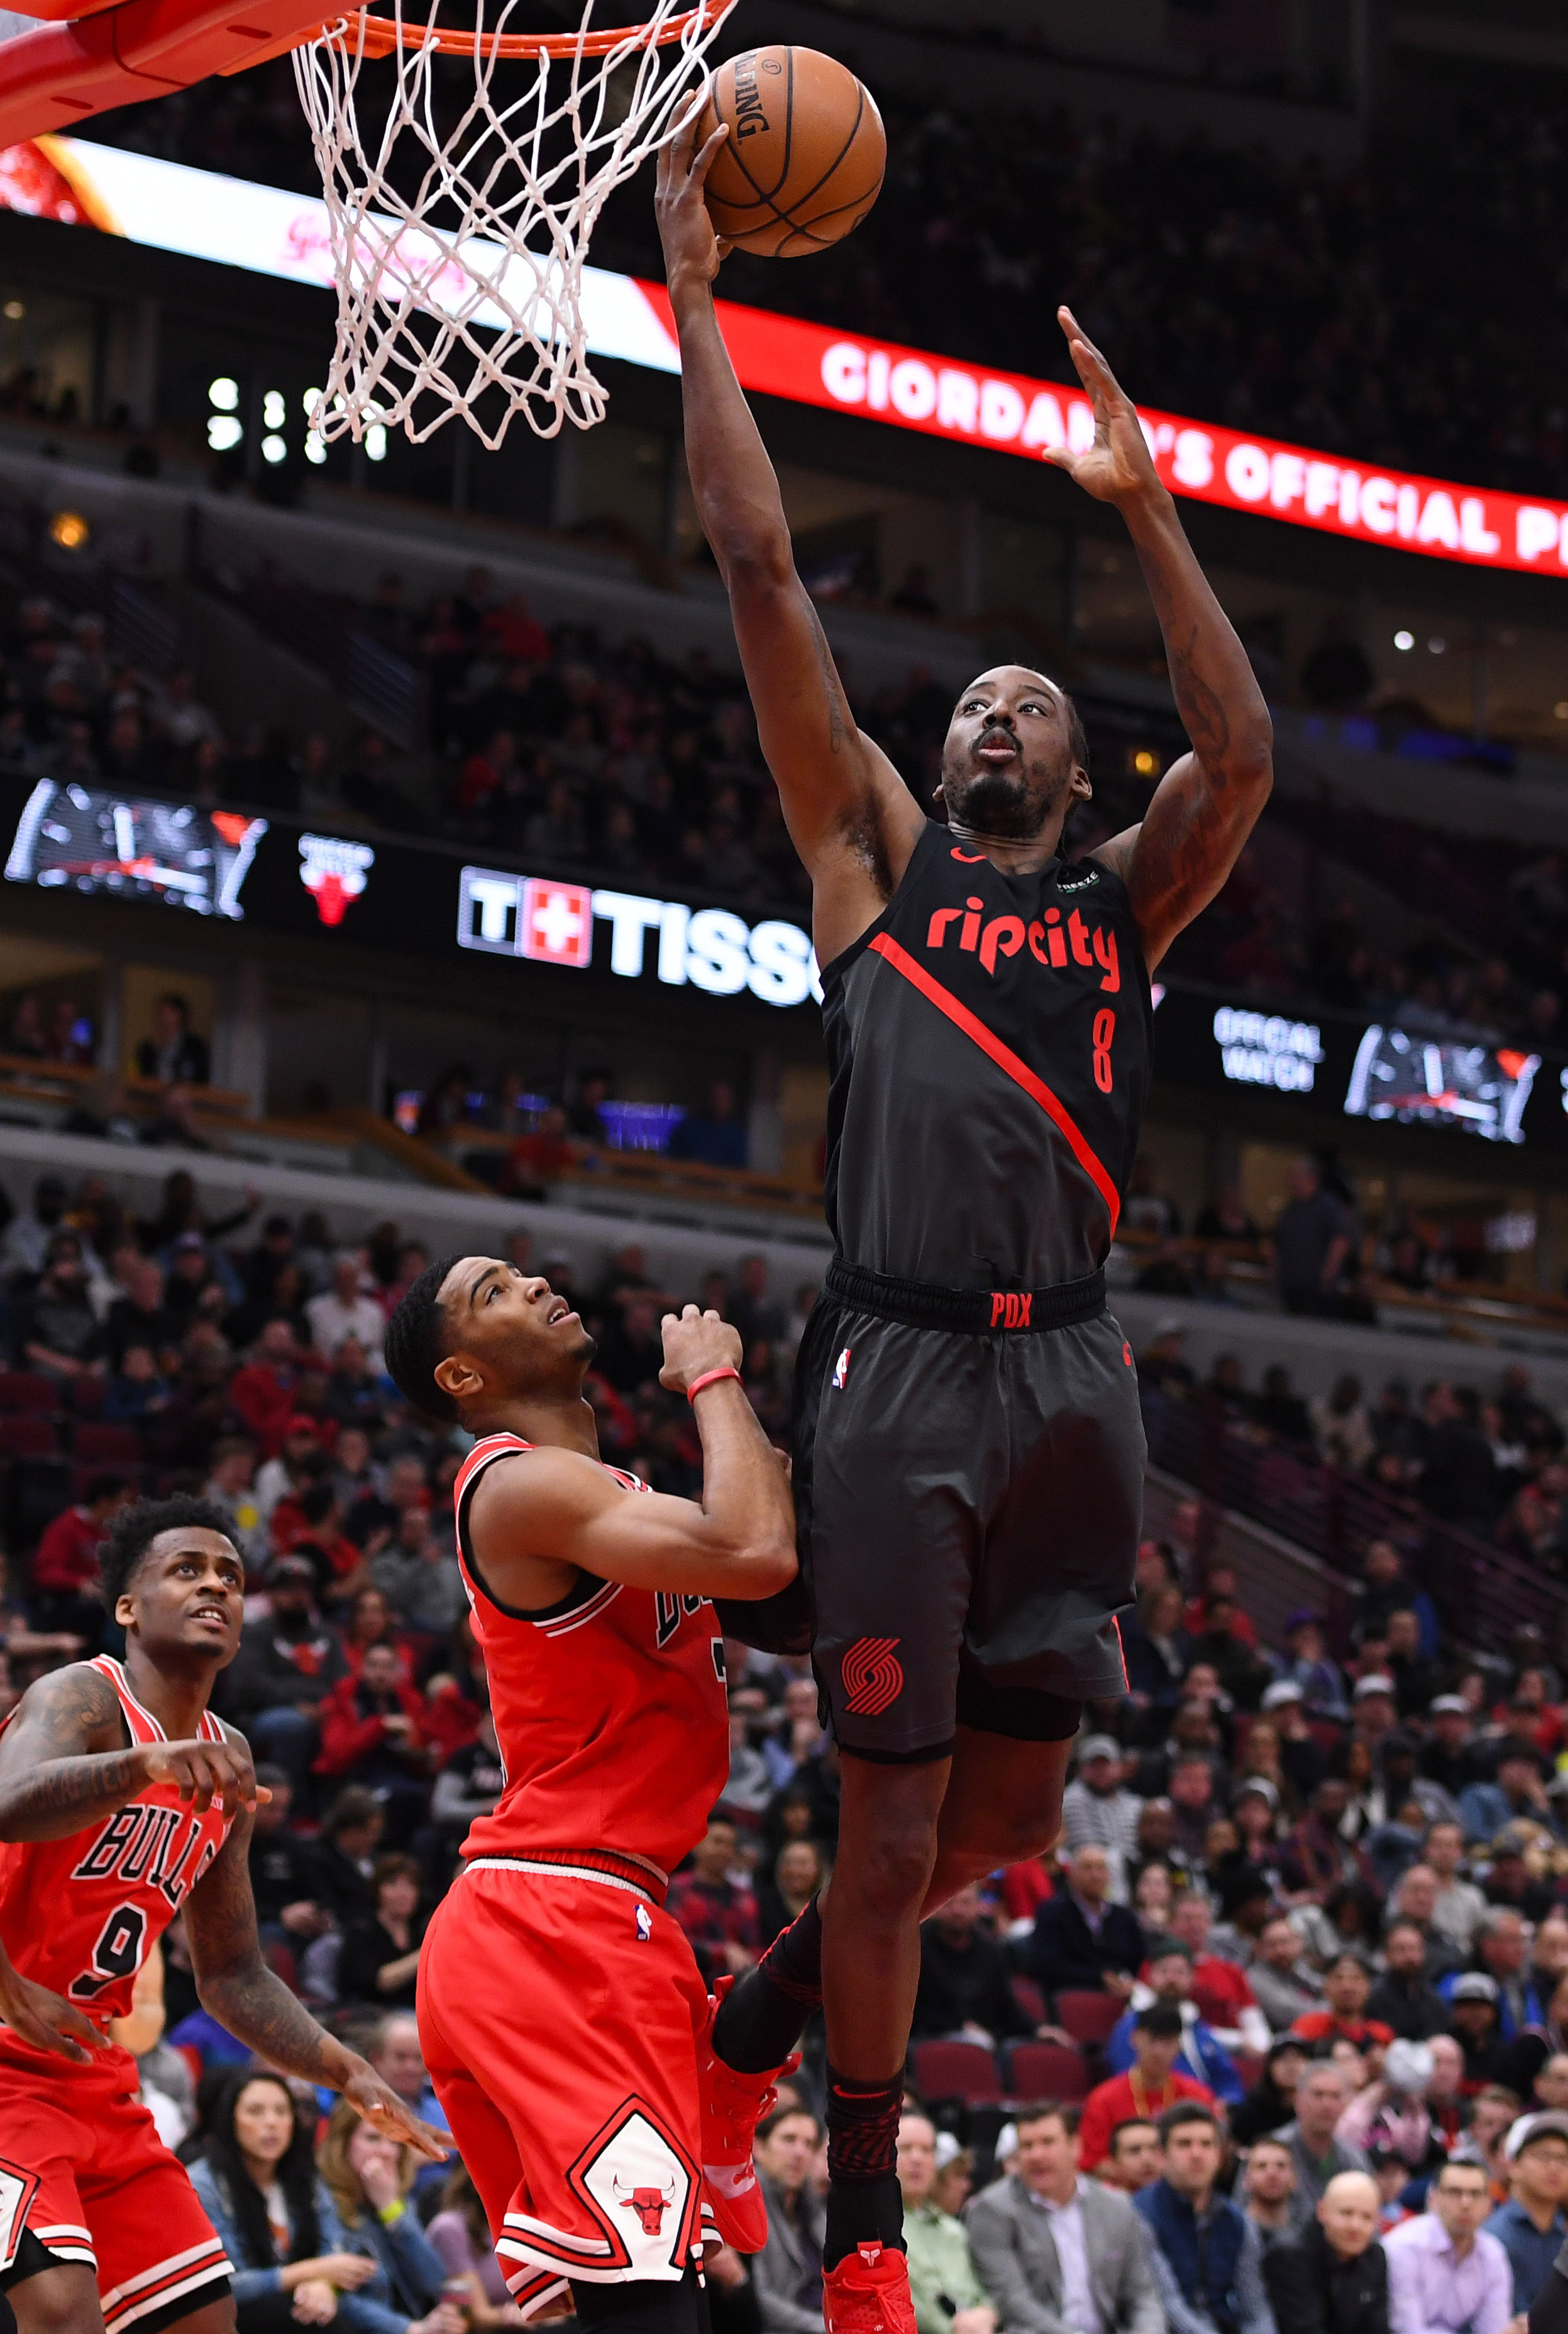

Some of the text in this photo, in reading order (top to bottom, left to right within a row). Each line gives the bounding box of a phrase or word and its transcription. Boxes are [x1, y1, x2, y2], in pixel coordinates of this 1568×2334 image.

[1225, 443, 1501, 557] OFFICIAL
[591, 888, 825, 1007] TISS
[1092, 1007, 1115, 1094] 8
[990, 1292, 1033, 1328] PDX
[68, 1900, 147, 2000] 9
